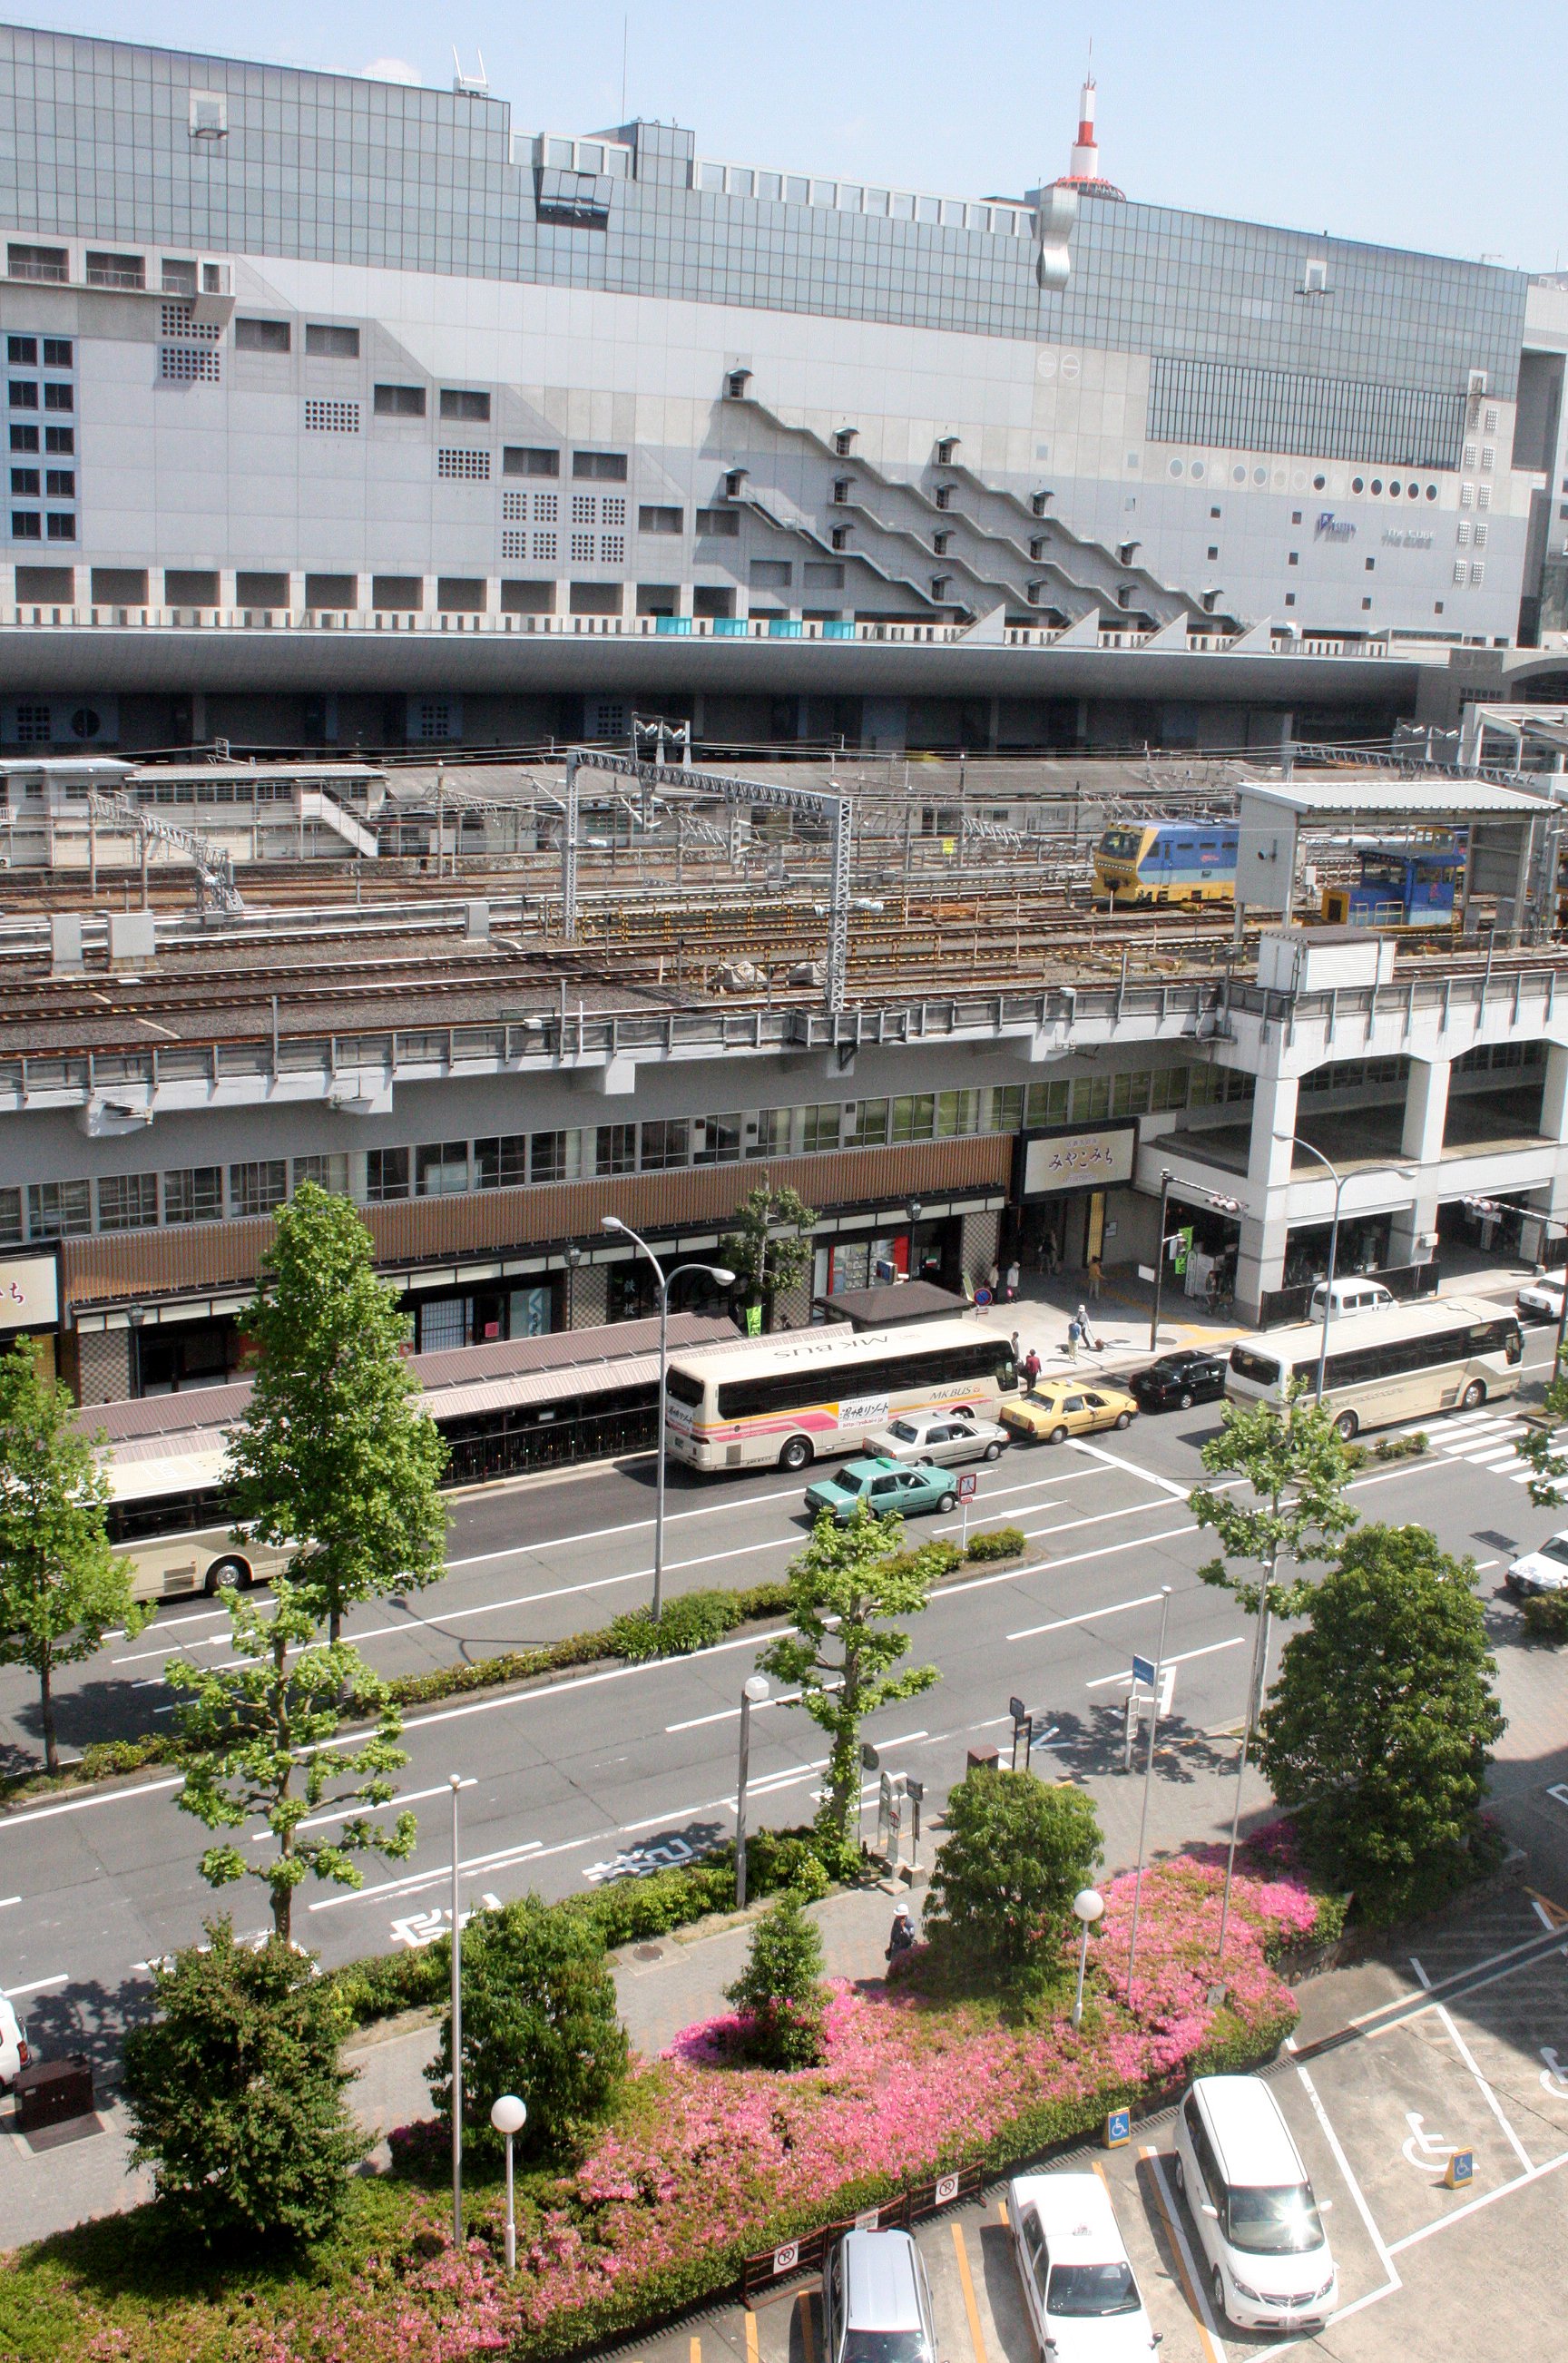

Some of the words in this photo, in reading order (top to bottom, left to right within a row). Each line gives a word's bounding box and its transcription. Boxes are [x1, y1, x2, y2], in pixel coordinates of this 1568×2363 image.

[1048, 1147, 1113, 1172] みやこみち
[843, 1336, 888, 1349] MK
[773, 1344, 833, 1359] BUS
[929, 1390, 950, 1401] MK
[949, 1386, 973, 1397] BUS
